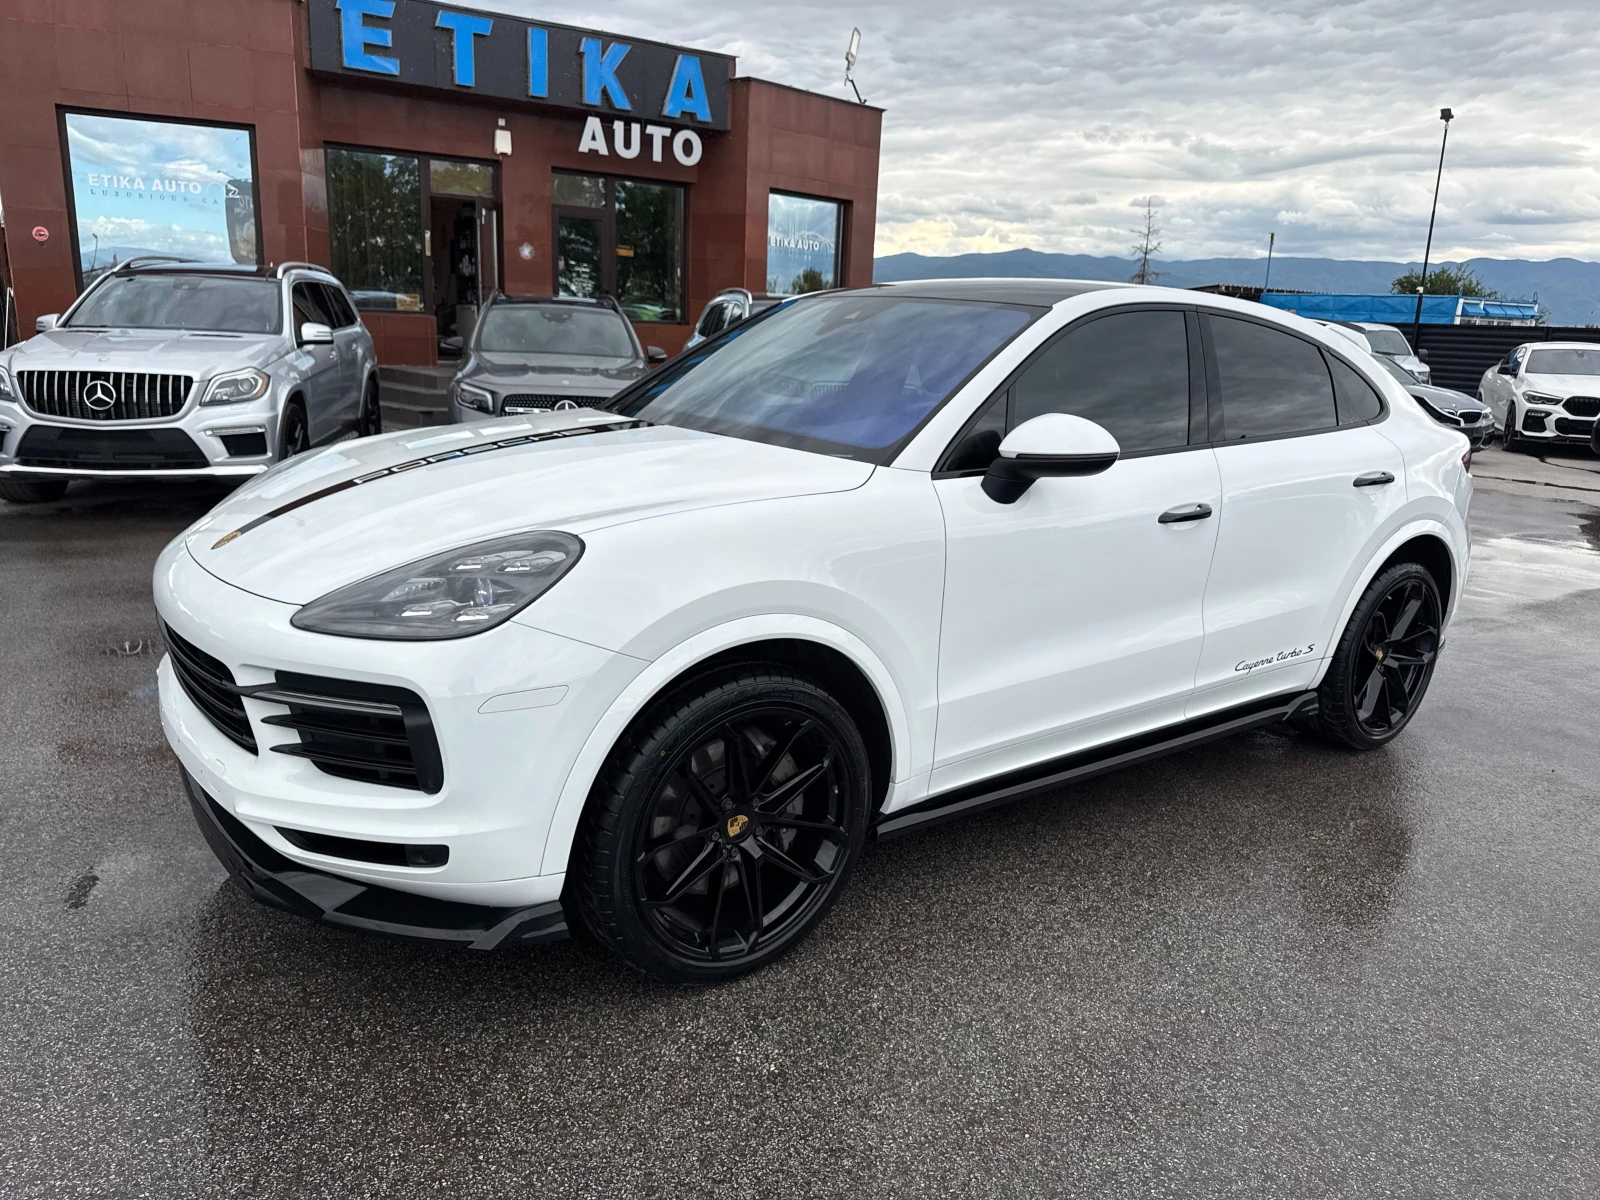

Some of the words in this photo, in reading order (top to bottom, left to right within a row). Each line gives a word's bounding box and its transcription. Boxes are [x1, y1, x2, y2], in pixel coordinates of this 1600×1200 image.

[335, 0, 712, 122] ETIKA
[578, 116, 702, 167] AUTO
[88, 173, 145, 190] ETIKA
[152, 178, 202, 195] AUTO
[90, 188, 188, 203] LUXURIOUS
[770, 236, 795, 249] ETIKA
[797, 239, 819, 251] AUTO
[353, 427, 596, 484] PORSCHE
[1234, 656, 1274, 675] Cayenne
[1303, 643, 1315, 655] S
